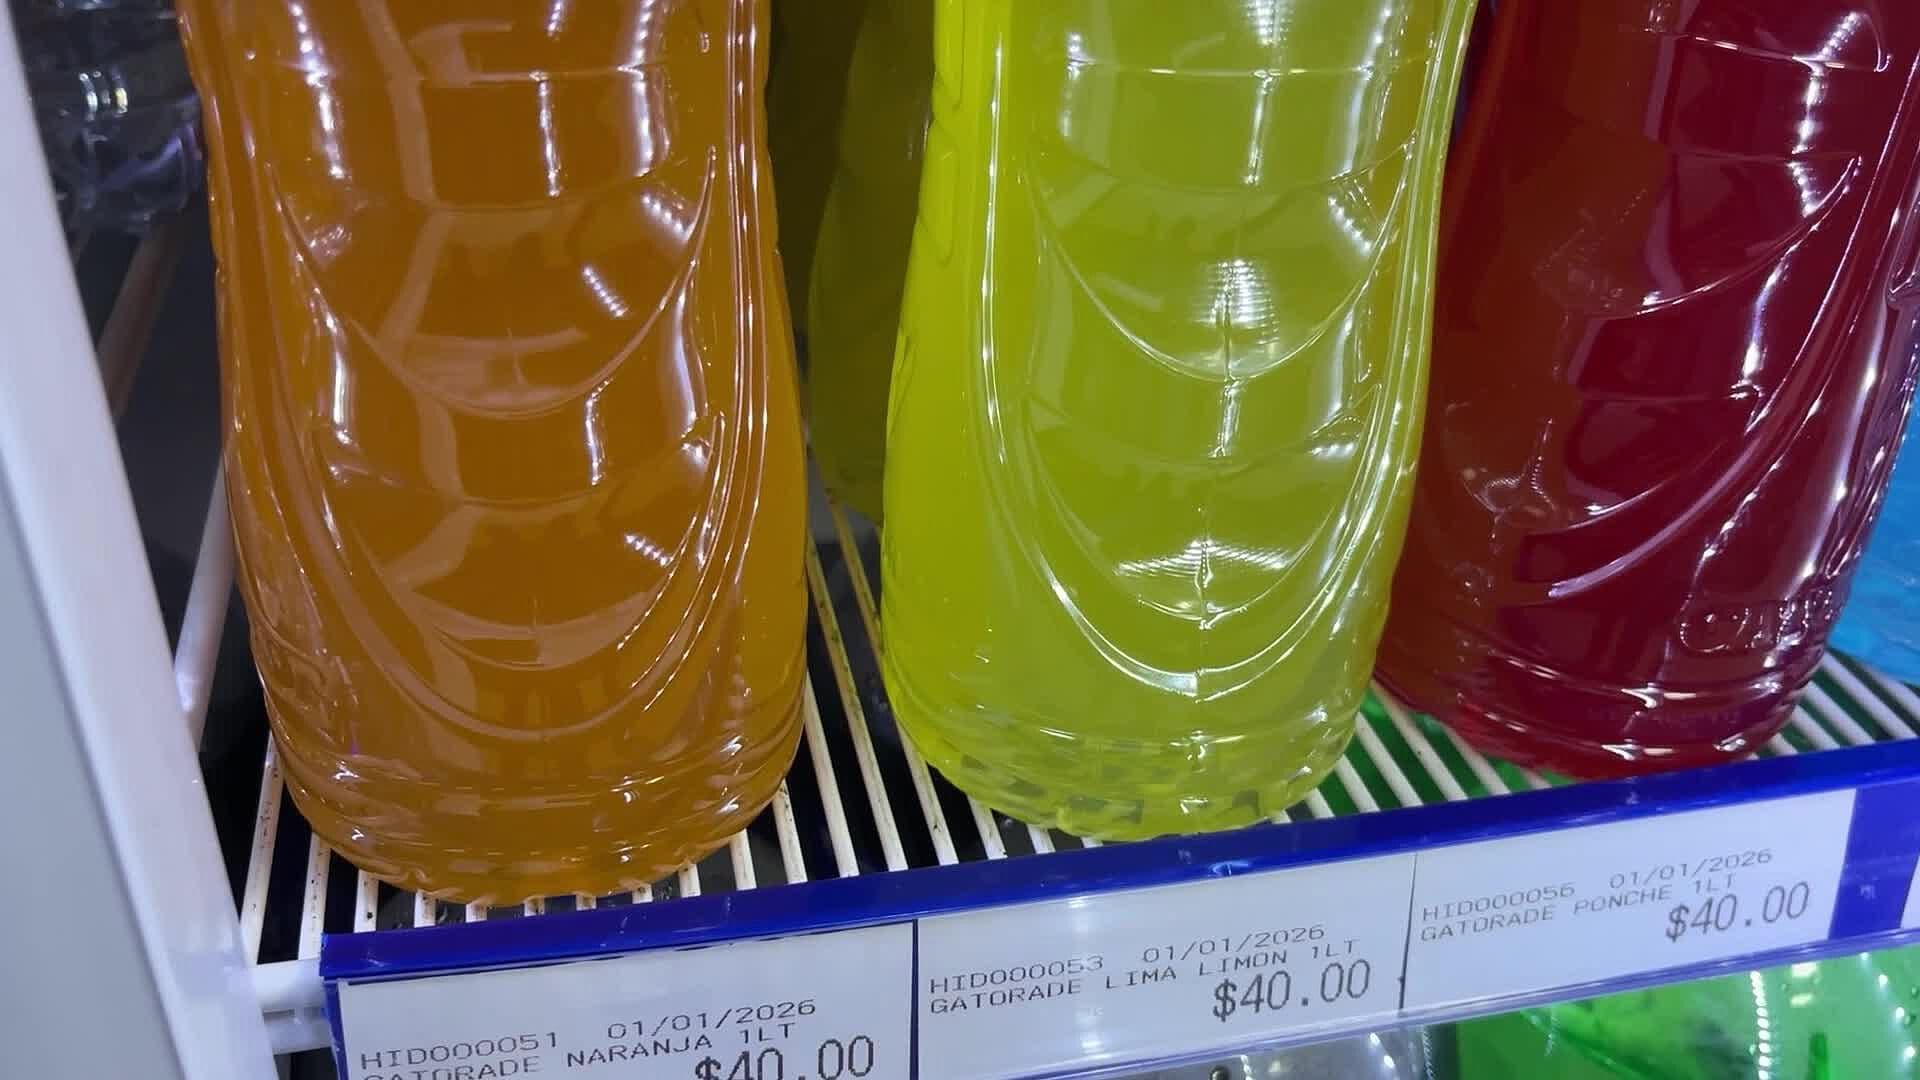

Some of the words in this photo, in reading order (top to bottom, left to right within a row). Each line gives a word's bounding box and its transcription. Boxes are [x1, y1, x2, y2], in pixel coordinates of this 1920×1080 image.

[1420, 904, 1554, 943] GATORADE
[1573, 885, 1672, 916] PONCHE
[1694, 873, 1737, 895] 1LT
[1422, 882, 1576, 921] HID000056
[1609, 848, 1773, 889] 01/01/2026
[1665, 881, 1811, 943] $40.00
[930, 956, 1104, 994] HID000053
[1142, 924, 1325, 963] 01/01/2026
[930, 979, 1081, 1014] GATORADE
[1105, 968, 1178, 989] LIMA
[1199, 949, 1287, 977] LIMON
[1311, 938, 1360, 960] 1LT
[1212, 959, 1371, 1022] $40.00
[361, 1031, 558, 1071] HID000051
[607, 998, 816, 1040] 01/01/2026
[566, 1035, 713, 1068] NARANJA
[738, 1023, 796, 1044] 1LT
